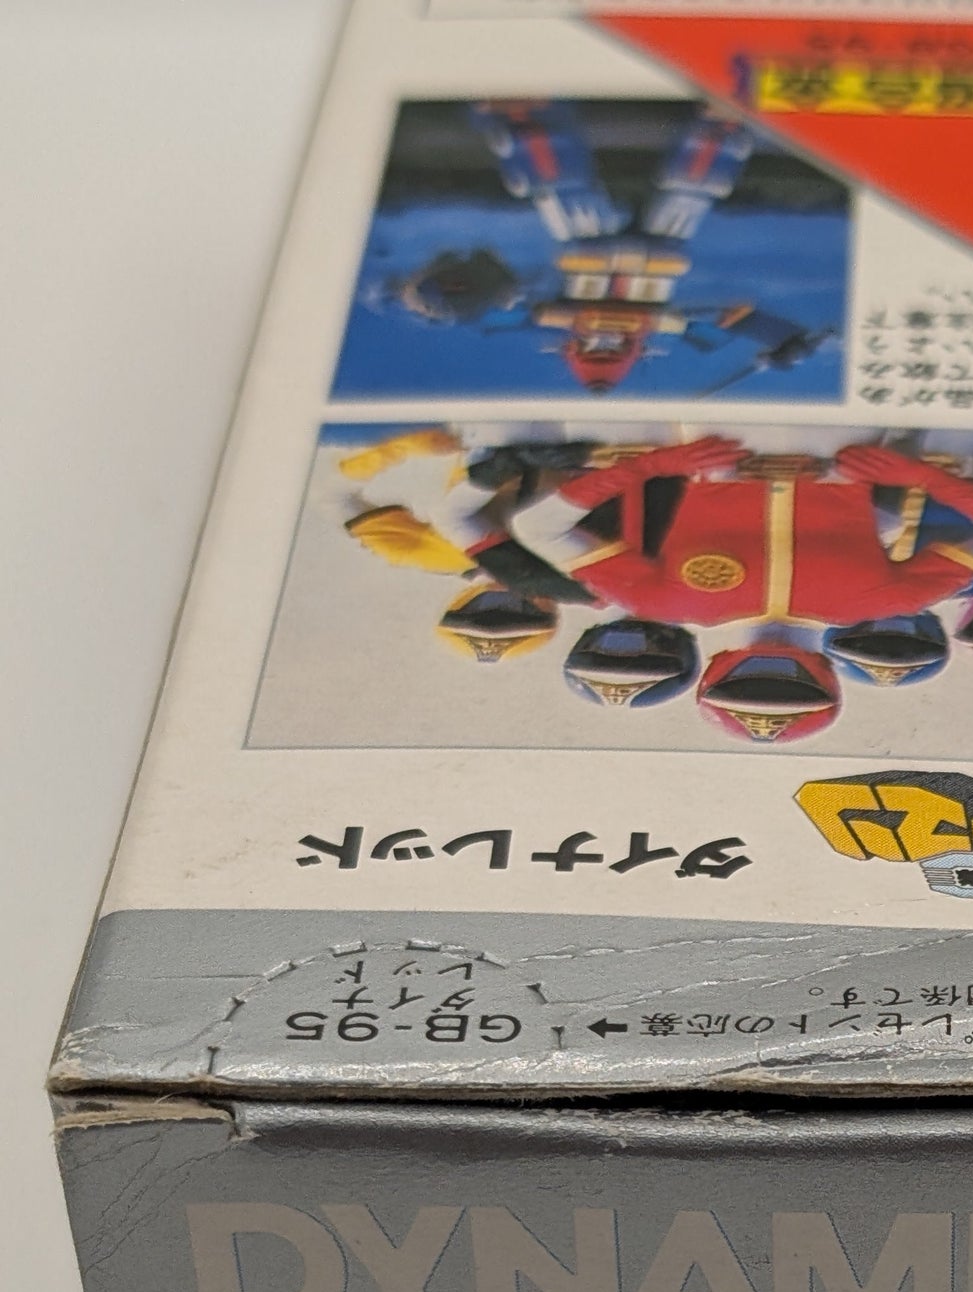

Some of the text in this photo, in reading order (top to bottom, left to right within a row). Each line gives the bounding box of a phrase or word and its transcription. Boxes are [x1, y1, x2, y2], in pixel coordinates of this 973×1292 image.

[295, 825, 753, 881] ダイナレッド
[332, 961, 475, 985] レッド
[331, 986, 476, 1012] ダイナ
[284, 1011, 522, 1044] GB-95
